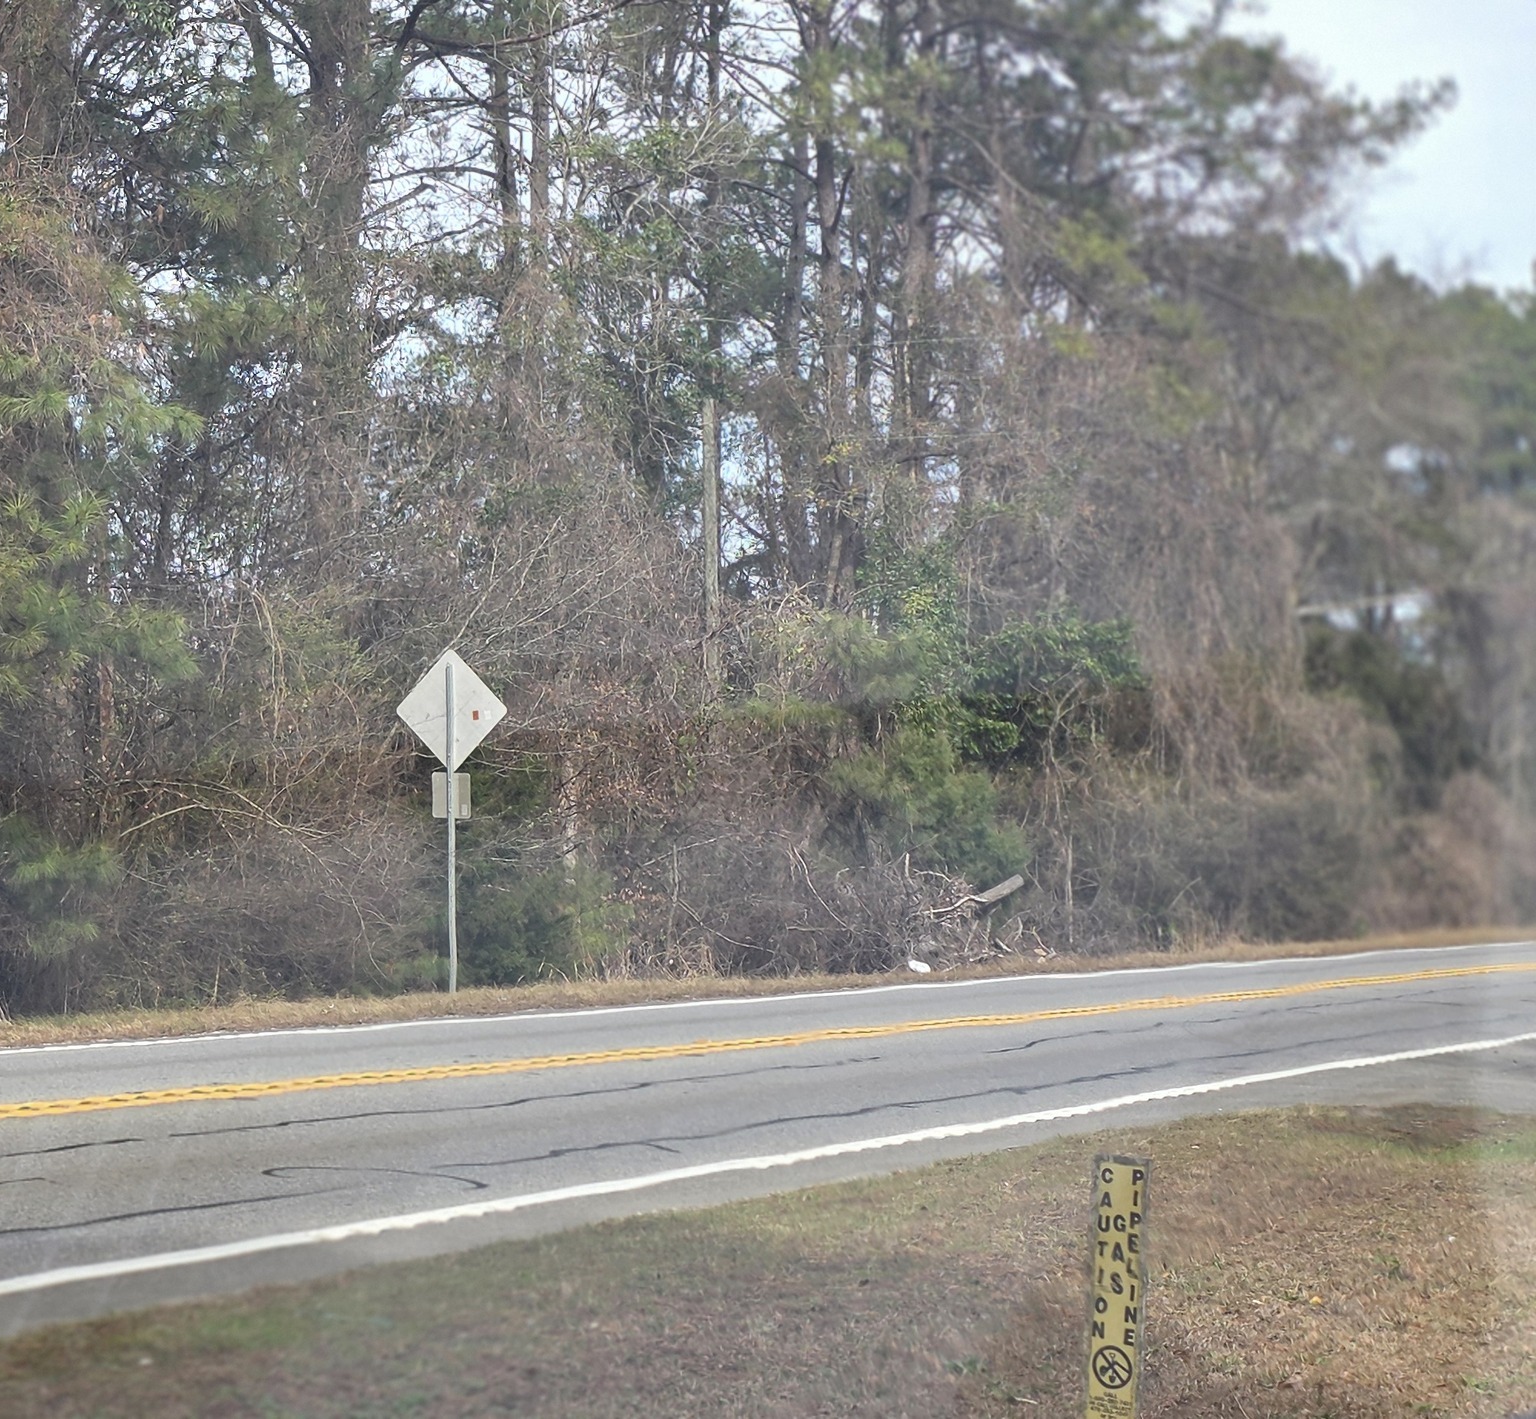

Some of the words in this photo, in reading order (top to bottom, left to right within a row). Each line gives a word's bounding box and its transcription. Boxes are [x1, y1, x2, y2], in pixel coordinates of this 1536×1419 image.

[1092, 1168, 1114, 1339] CAUTION
[1110, 1214, 1126, 1295] GAS
[1123, 1169, 1144, 1347] PIPELINE
